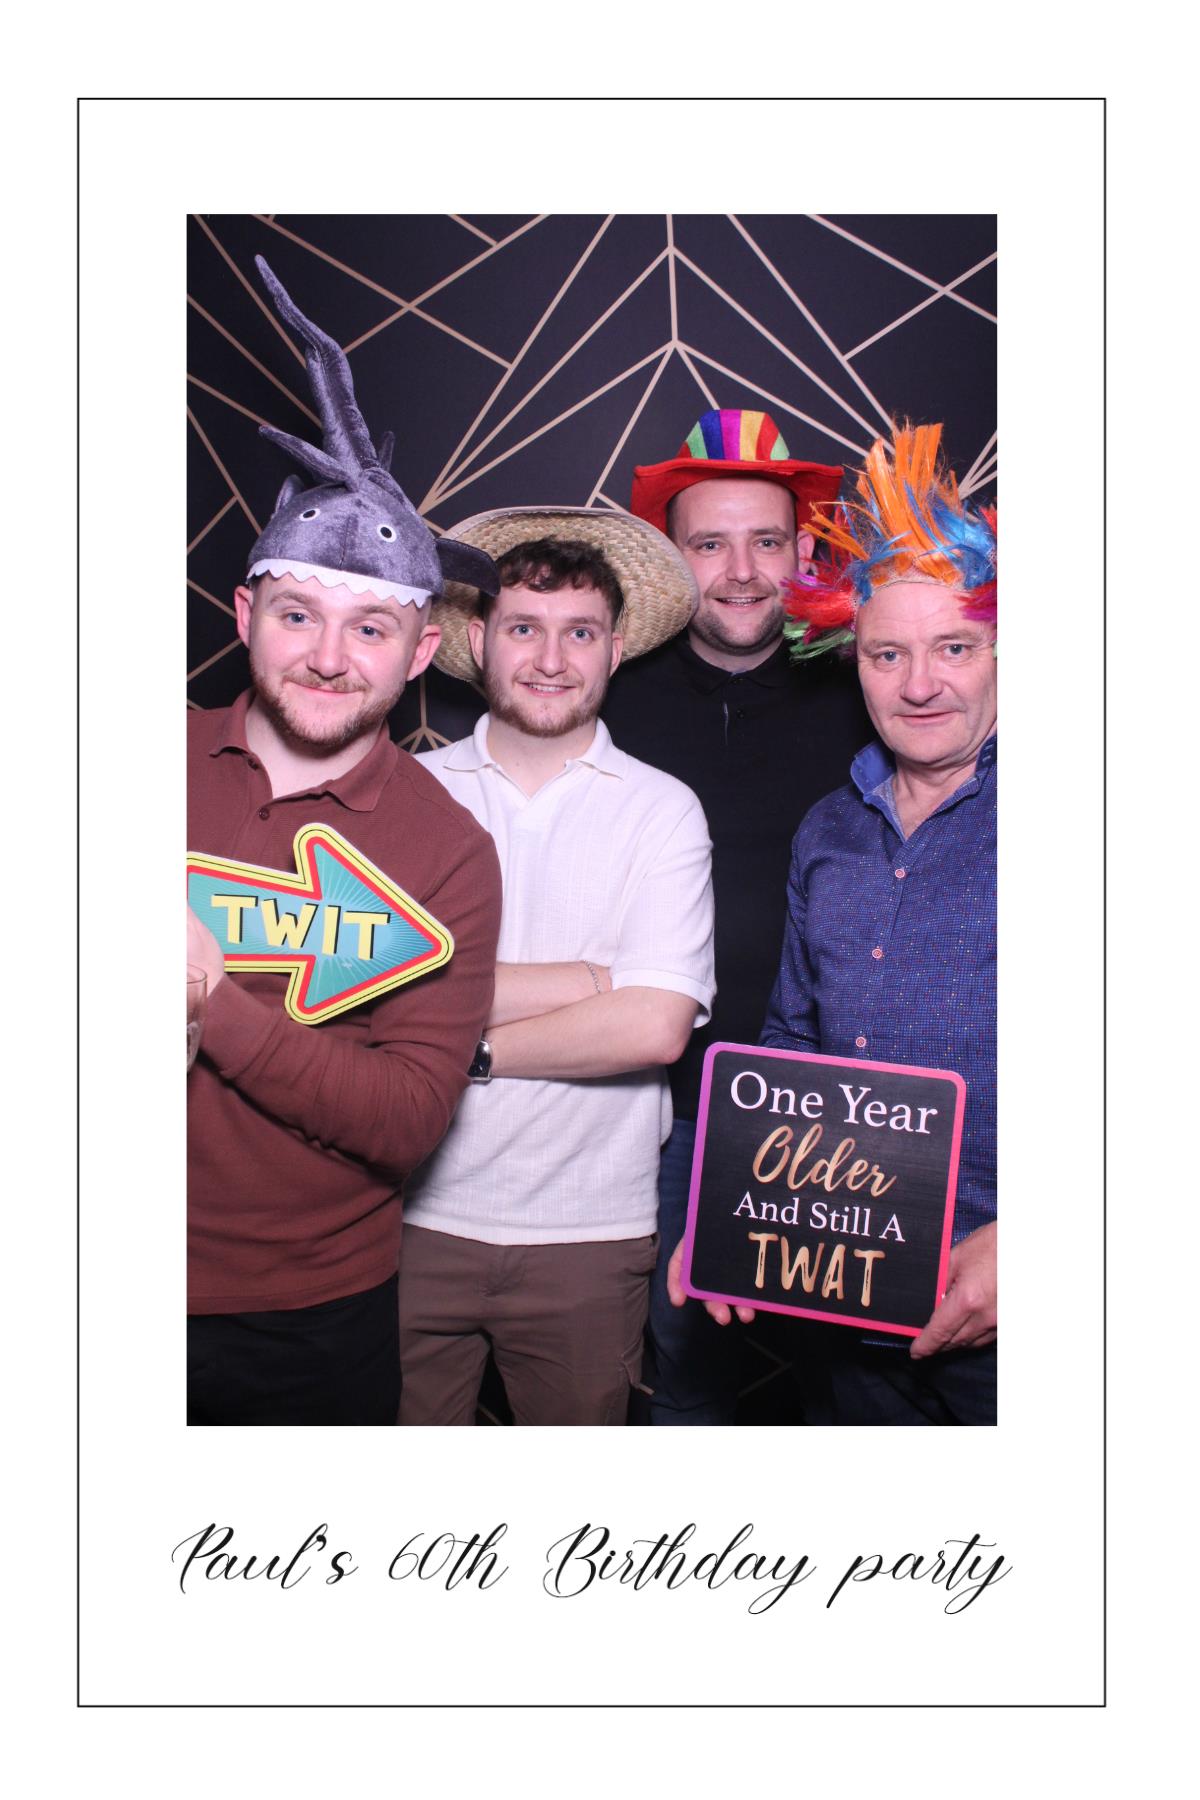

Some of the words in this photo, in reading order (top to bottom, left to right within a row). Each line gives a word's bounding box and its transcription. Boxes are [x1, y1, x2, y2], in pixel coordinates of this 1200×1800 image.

[211, 894, 391, 962] TWIT
[730, 1070, 824, 1119] One
[837, 1083, 939, 1135] Year
[752, 1123, 897, 1198] Older
[732, 1191, 800, 1225] And
[809, 1202, 871, 1237] Still
[878, 1213, 906, 1243] A
[747, 1231, 886, 1307] TWAT
